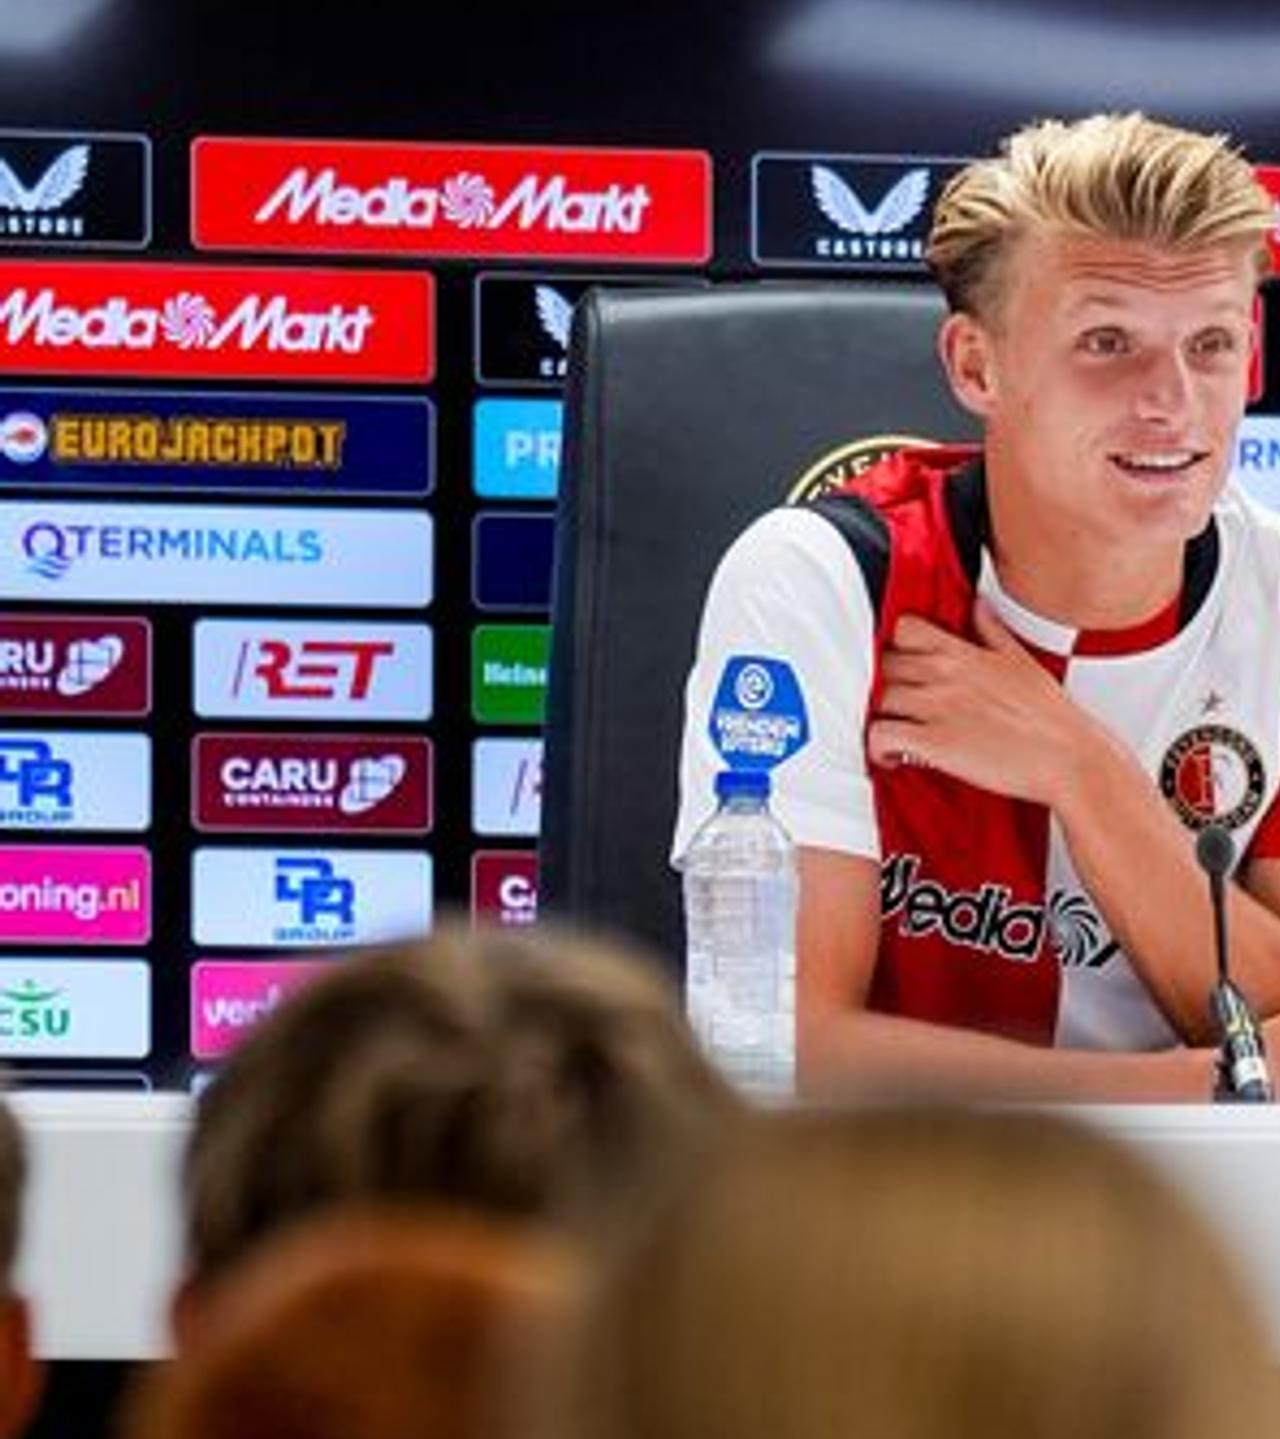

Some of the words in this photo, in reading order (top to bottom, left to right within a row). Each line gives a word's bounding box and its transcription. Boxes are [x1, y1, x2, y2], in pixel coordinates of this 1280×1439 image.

[254, 168, 436, 227] Media
[490, 173, 651, 233] Markt
[209, 293, 373, 353] Markt
[52, 416, 345, 468] EUROJACKPOT
[0, 641, 54, 673] RU
[221, 758, 336, 791] CARU
[0, 877, 139, 920] oning.nl
